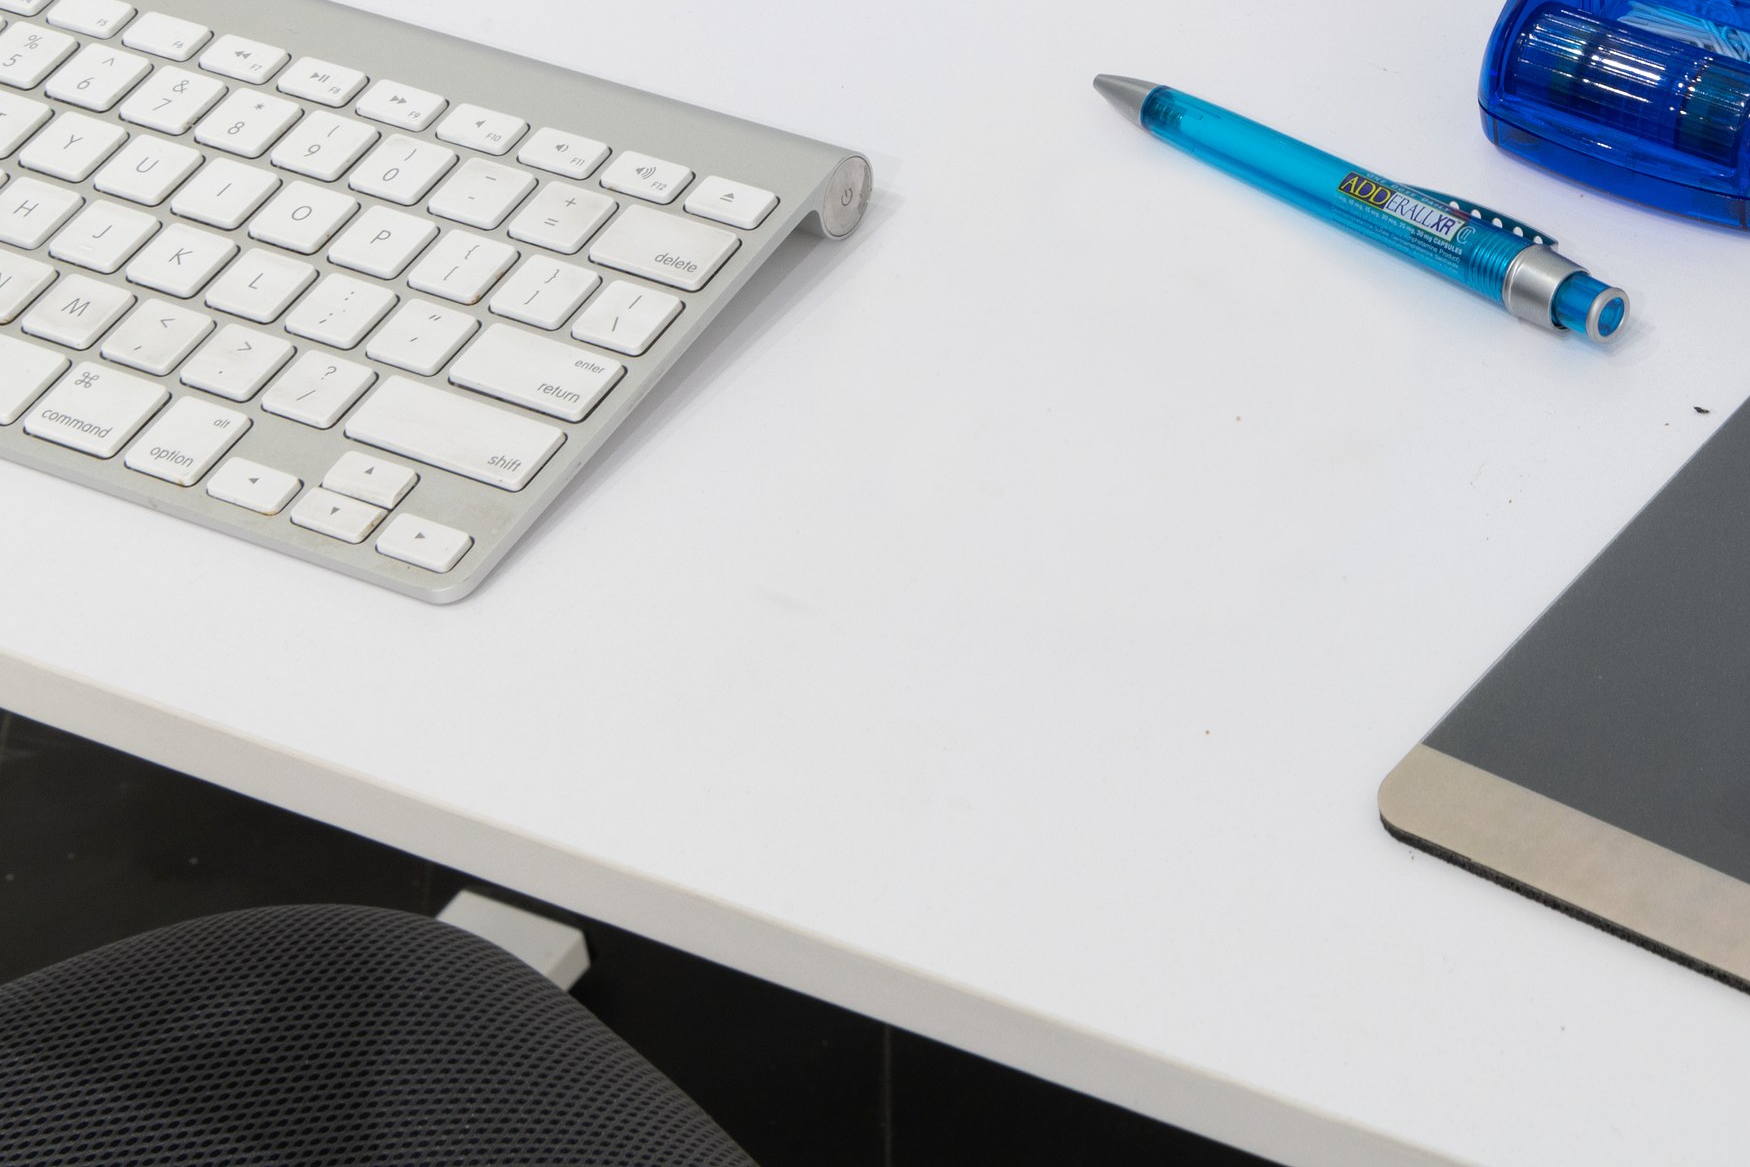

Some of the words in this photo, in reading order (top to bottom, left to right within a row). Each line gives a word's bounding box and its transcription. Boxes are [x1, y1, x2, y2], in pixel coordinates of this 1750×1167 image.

[2, 53, 23, 67] 5
[77, 77, 95, 90] 6
[152, 98, 172, 112] 7
[227, 121, 245, 136] 8
[63, 134, 83, 150] Y
[304, 143, 321, 159] 9
[135, 157, 159, 174] U
[13, 200, 39, 218] H
[1340, 175, 1433, 228] ADDERALL
[92, 224, 112, 239] J
[370, 229, 391, 245] P
[168, 247, 193, 266] K
[654, 250, 698, 274] delete
[248, 273, 265, 290] L
[61, 298, 91, 318] M
[574, 358, 605, 375] enter
[537, 381, 580, 403] return
[41, 407, 113, 439] command
[213, 416, 231, 429] alt
[150, 445, 195, 469] option
[487, 454, 522, 472] shift
